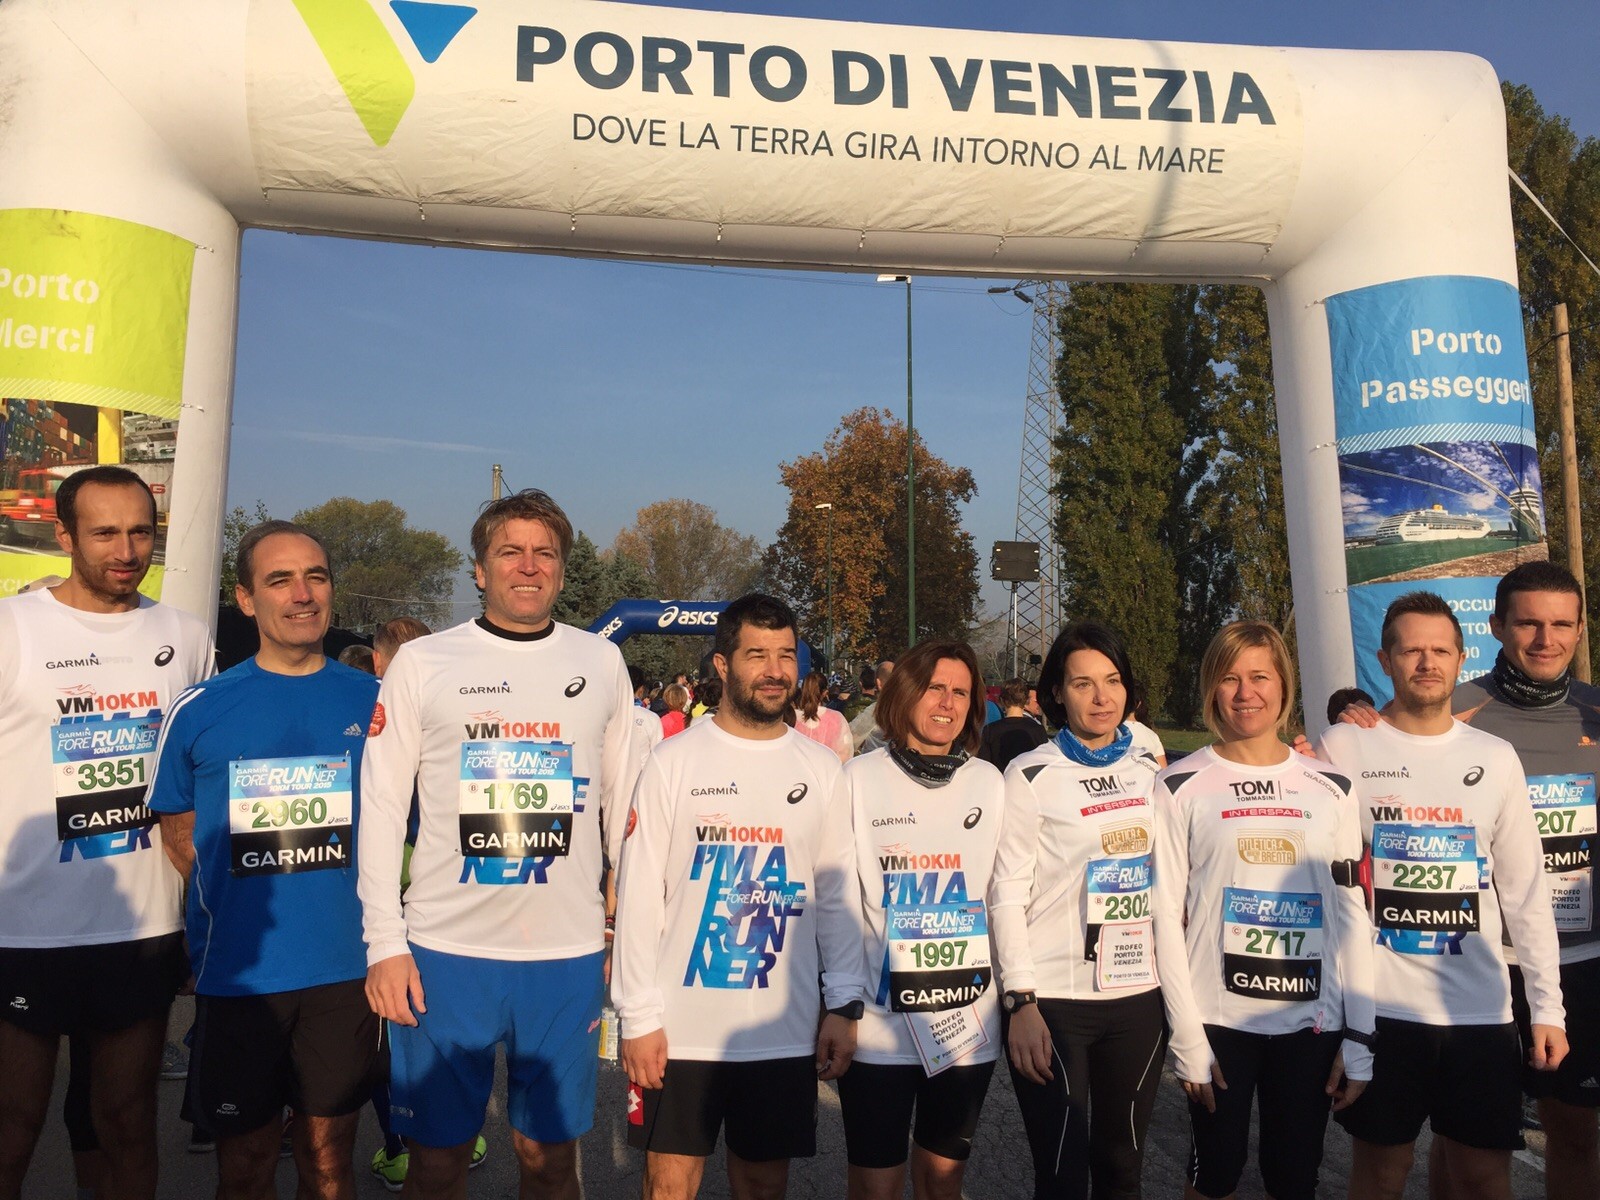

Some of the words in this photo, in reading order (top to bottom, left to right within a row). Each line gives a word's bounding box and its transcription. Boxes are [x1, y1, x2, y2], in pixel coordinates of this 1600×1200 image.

[517, 25, 807, 102] PORTO
[832, 50, 908, 109] DI
[929, 56, 1276, 125] VENEZIA
[573, 114, 667, 146] DOVE
[680, 122, 720, 150] LA
[730, 125, 834, 157] TERRA
[845, 131, 921, 162] GIRA
[932, 136, 1080, 169] INTORNO
[1089, 144, 1127, 170] AL
[1137, 146, 1225, 174] MARE
[1411, 328, 1502, 355] Porto
[1361, 375, 1530, 408] Passeggeri
[1447, 599, 1495, 612] OCCU
[678, 611, 719, 625] asics
[46, 658, 100, 669] GARMIN
[459, 686, 510, 695] GARMIN
[56, 691, 158, 714] VM10KM
[59, 730, 91, 738] GARMIN
[465, 722, 560, 740] VM10KM
[116, 743, 135, 751] TOUR
[78, 757, 145, 790] 3351
[237, 767, 269, 775] GARMIN
[538, 768, 555, 776] 2015
[1362, 771, 1409, 779] GARMIN
[292, 782, 312, 790] TOUR
[313, 781, 332, 789] 2015
[691, 787, 738, 796] GARMIN
[1079, 775, 1117, 793] TOM
[1229, 780, 1274, 796] TOM
[1303, 771, 1340, 800] DIADORA
[484, 783, 548, 810] 1769
[1089, 790, 1121, 799] TOMMASINI
[1566, 796, 1581, 804] 2015
[252, 797, 327, 828] 2960
[1087, 798, 1146, 814] INTERSPAR
[1229, 809, 1301, 817] INTERSPAR
[1370, 806, 1462, 822] VM10KM
[872, 817, 916, 827] GARMIN
[469, 832, 563, 849] GARMIN
[696, 826, 783, 843] VM10KM
[1240, 839, 1276, 850] ATLETICA
[242, 844, 342, 868] GARMIN
[756, 846, 787, 881] A
[879, 854, 961, 871] VM10KM
[1261, 852, 1293, 863] BRENTA
[1393, 863, 1457, 890] 2237
[1105, 892, 1150, 920] 2302
[1383, 907, 1473, 925] GARMIN
[958, 925, 972, 933] 2015
[1245, 928, 1306, 956] 2717
[910, 941, 968, 968] 1997
[683, 952, 777, 989] NER
[1233, 972, 1316, 992] GARMIN
[900, 985, 984, 1005] GARMIN
[929, 1011, 962, 1031] TROFEO
[932, 1022, 957, 1039] PORTO
[957, 1016, 965, 1028] DI
[935, 1024, 967, 1046] VENEZIA
